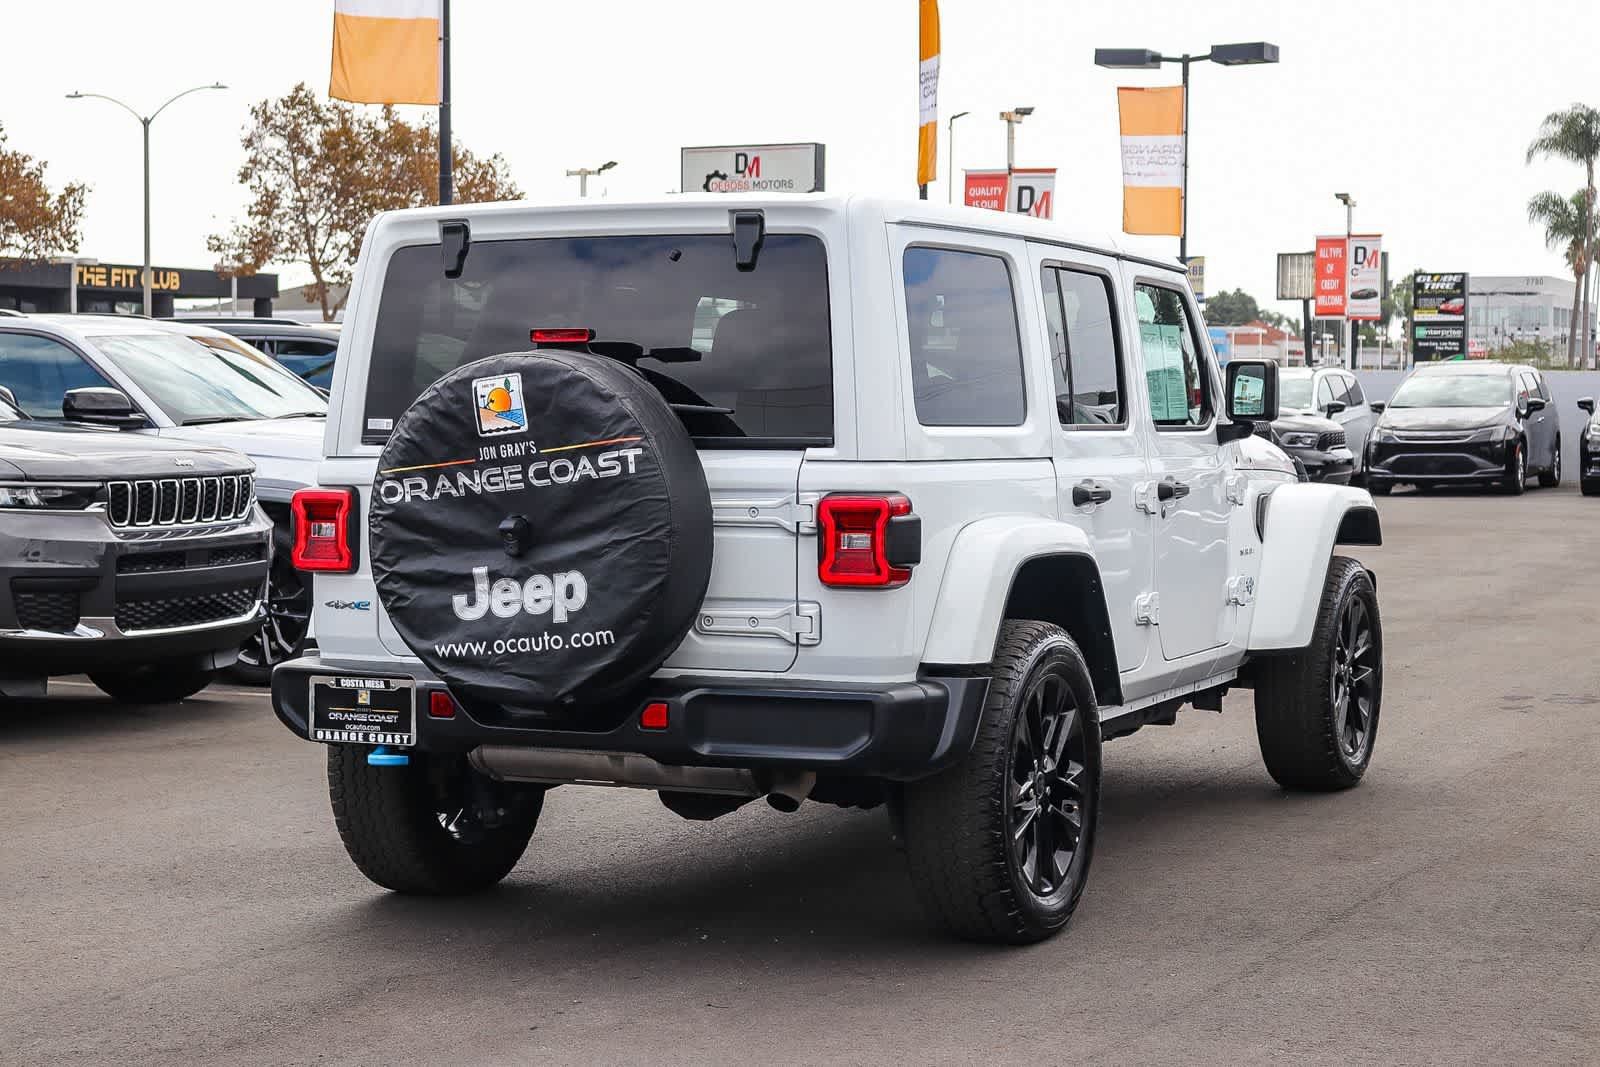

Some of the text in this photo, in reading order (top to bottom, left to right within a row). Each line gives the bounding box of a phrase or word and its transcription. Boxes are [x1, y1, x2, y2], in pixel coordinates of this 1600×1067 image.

[735, 153, 761, 178] DM
[752, 179, 794, 190] MOTORS
[969, 187, 1003, 197] QUALITY
[1017, 186, 1051, 219] DM
[1320, 248, 1329, 258] ALL
[1354, 246, 1379, 269] DM
[76, 266, 107, 286] THE
[111, 268, 137, 288] FIT
[1321, 280, 1340, 290] CREDIT
[1317, 296, 1343, 306] WELCOME
[479, 441, 538, 461] JON GRAY'S
[380, 448, 643, 504] ORANGE COAST
[452, 566, 588, 623] Jeep
[434, 629, 615, 657] www.ocauto.com
[340, 679, 385, 689] COSTA MESA
[328, 712, 399, 723] ORANGE COAST
[316, 730, 409, 744] ORANGE COAST
